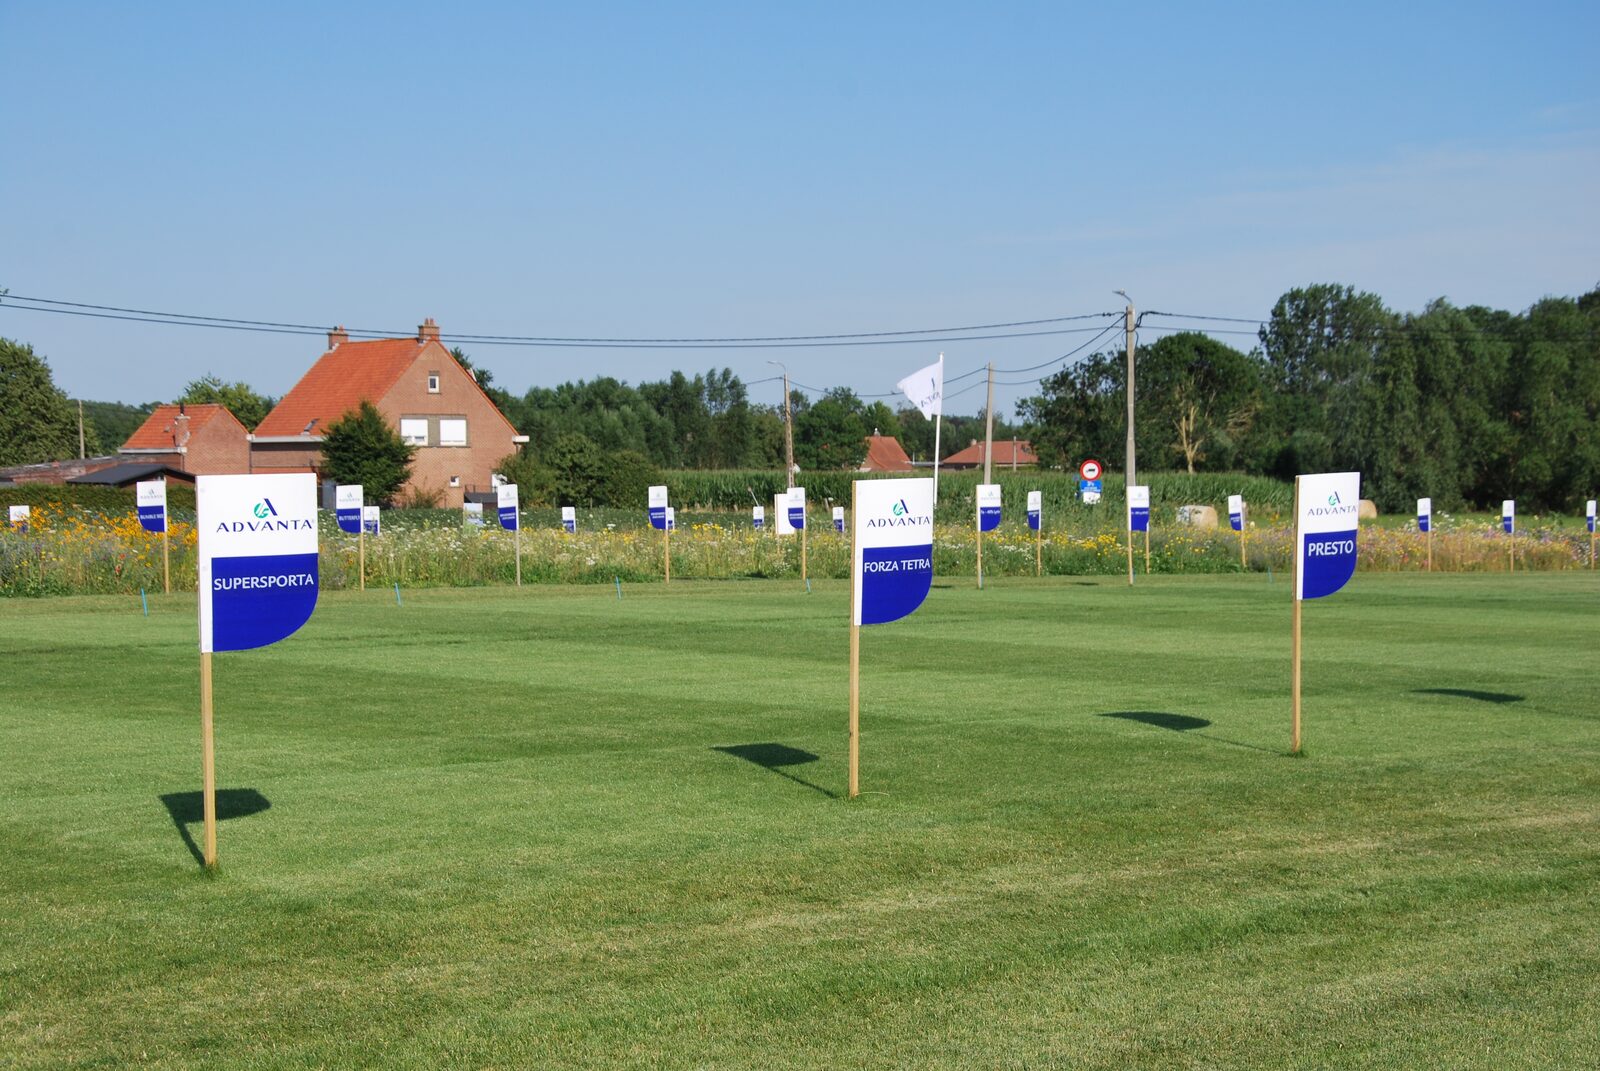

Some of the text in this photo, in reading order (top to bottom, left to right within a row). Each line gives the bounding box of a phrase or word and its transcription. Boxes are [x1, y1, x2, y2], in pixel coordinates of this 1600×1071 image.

[1308, 505, 1357, 516] ADVANTA
[216, 519, 313, 533] ADVANTA
[867, 516, 931, 528] ADVANTA
[1308, 540, 1354, 556] PRESTO
[864, 558, 931, 573] FORZA TETRA
[214, 573, 314, 590] SUPERSPORTA
